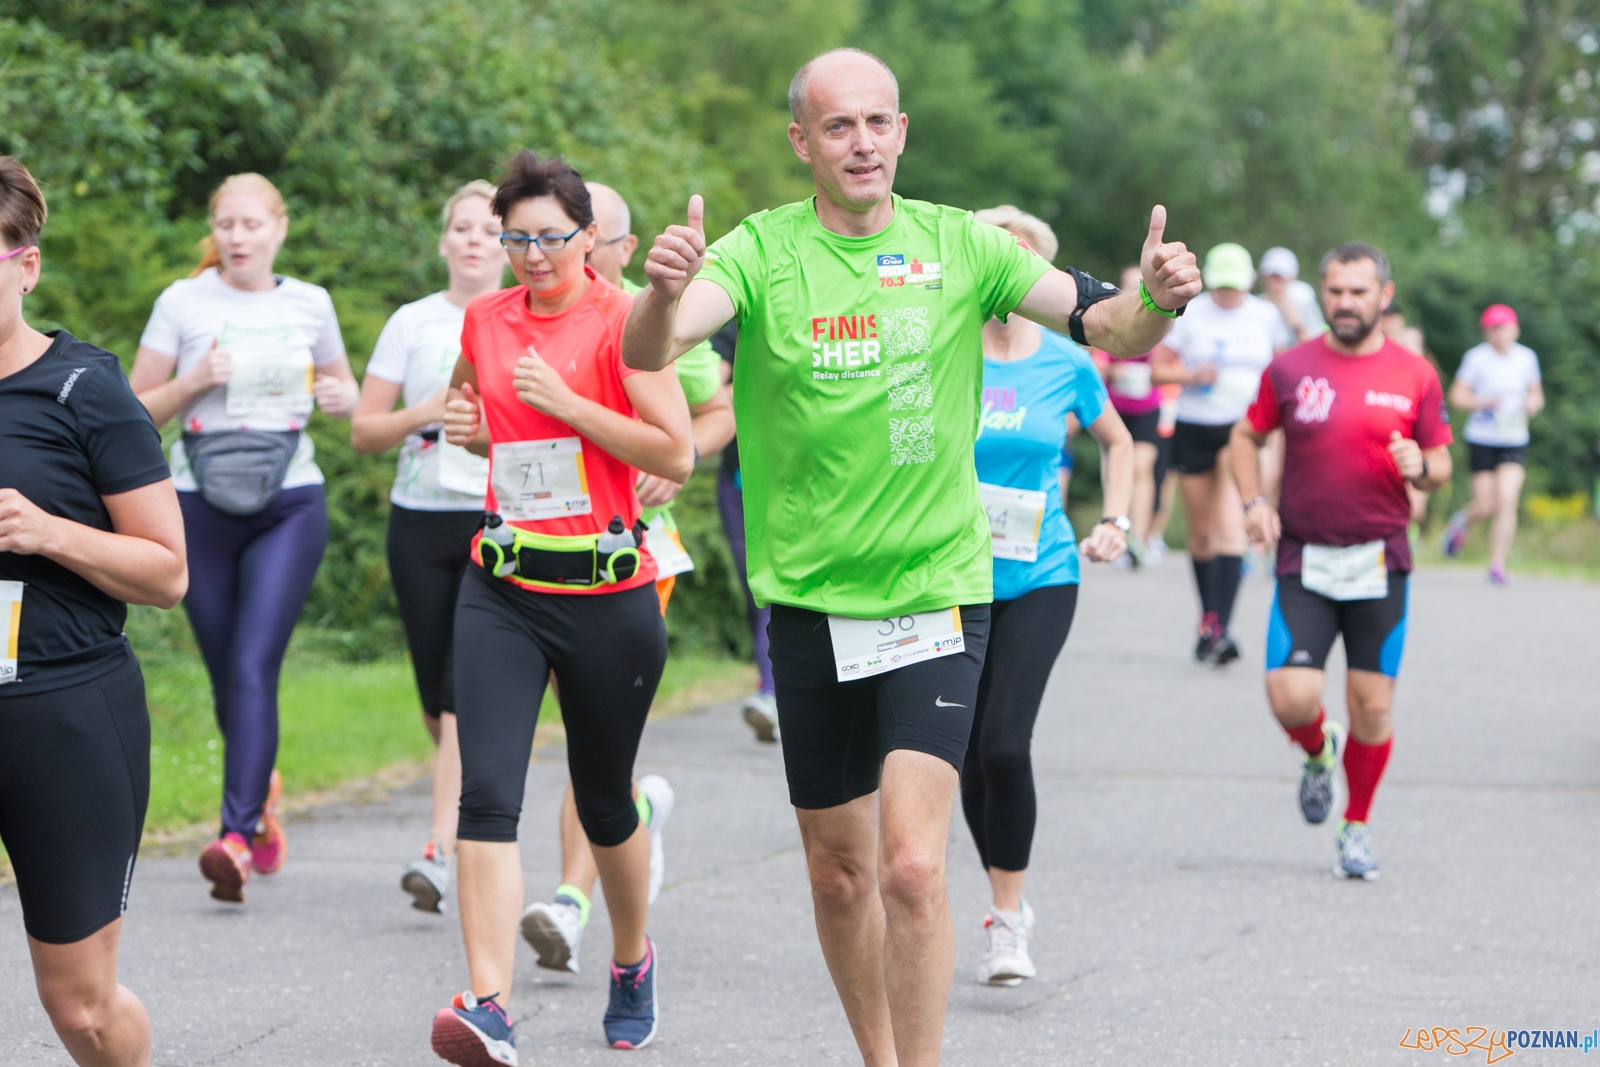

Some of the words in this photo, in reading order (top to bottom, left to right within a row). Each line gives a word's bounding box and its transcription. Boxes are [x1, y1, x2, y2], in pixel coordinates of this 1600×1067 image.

[879, 275, 905, 288] 70.3
[813, 371, 839, 381] Relay
[841, 369, 880, 379] distance
[57, 371, 80, 405] Reebok
[520, 462, 544, 487] 71
[942, 636, 962, 647] mjp
